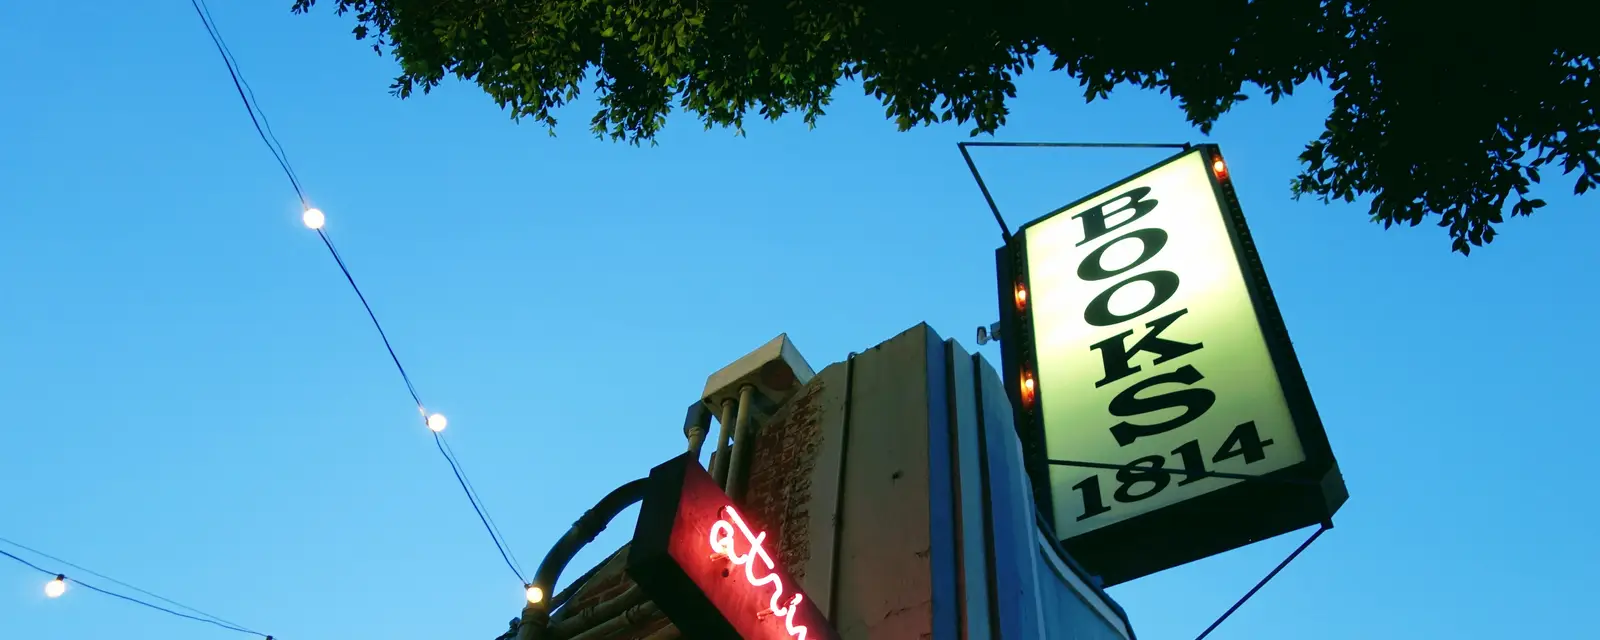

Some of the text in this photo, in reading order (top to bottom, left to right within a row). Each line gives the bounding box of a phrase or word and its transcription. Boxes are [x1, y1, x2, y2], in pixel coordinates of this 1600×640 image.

[1071, 186, 1216, 447] BOOKS
[1071, 420, 1274, 522] 1814
[709, 504, 808, 640] atri
